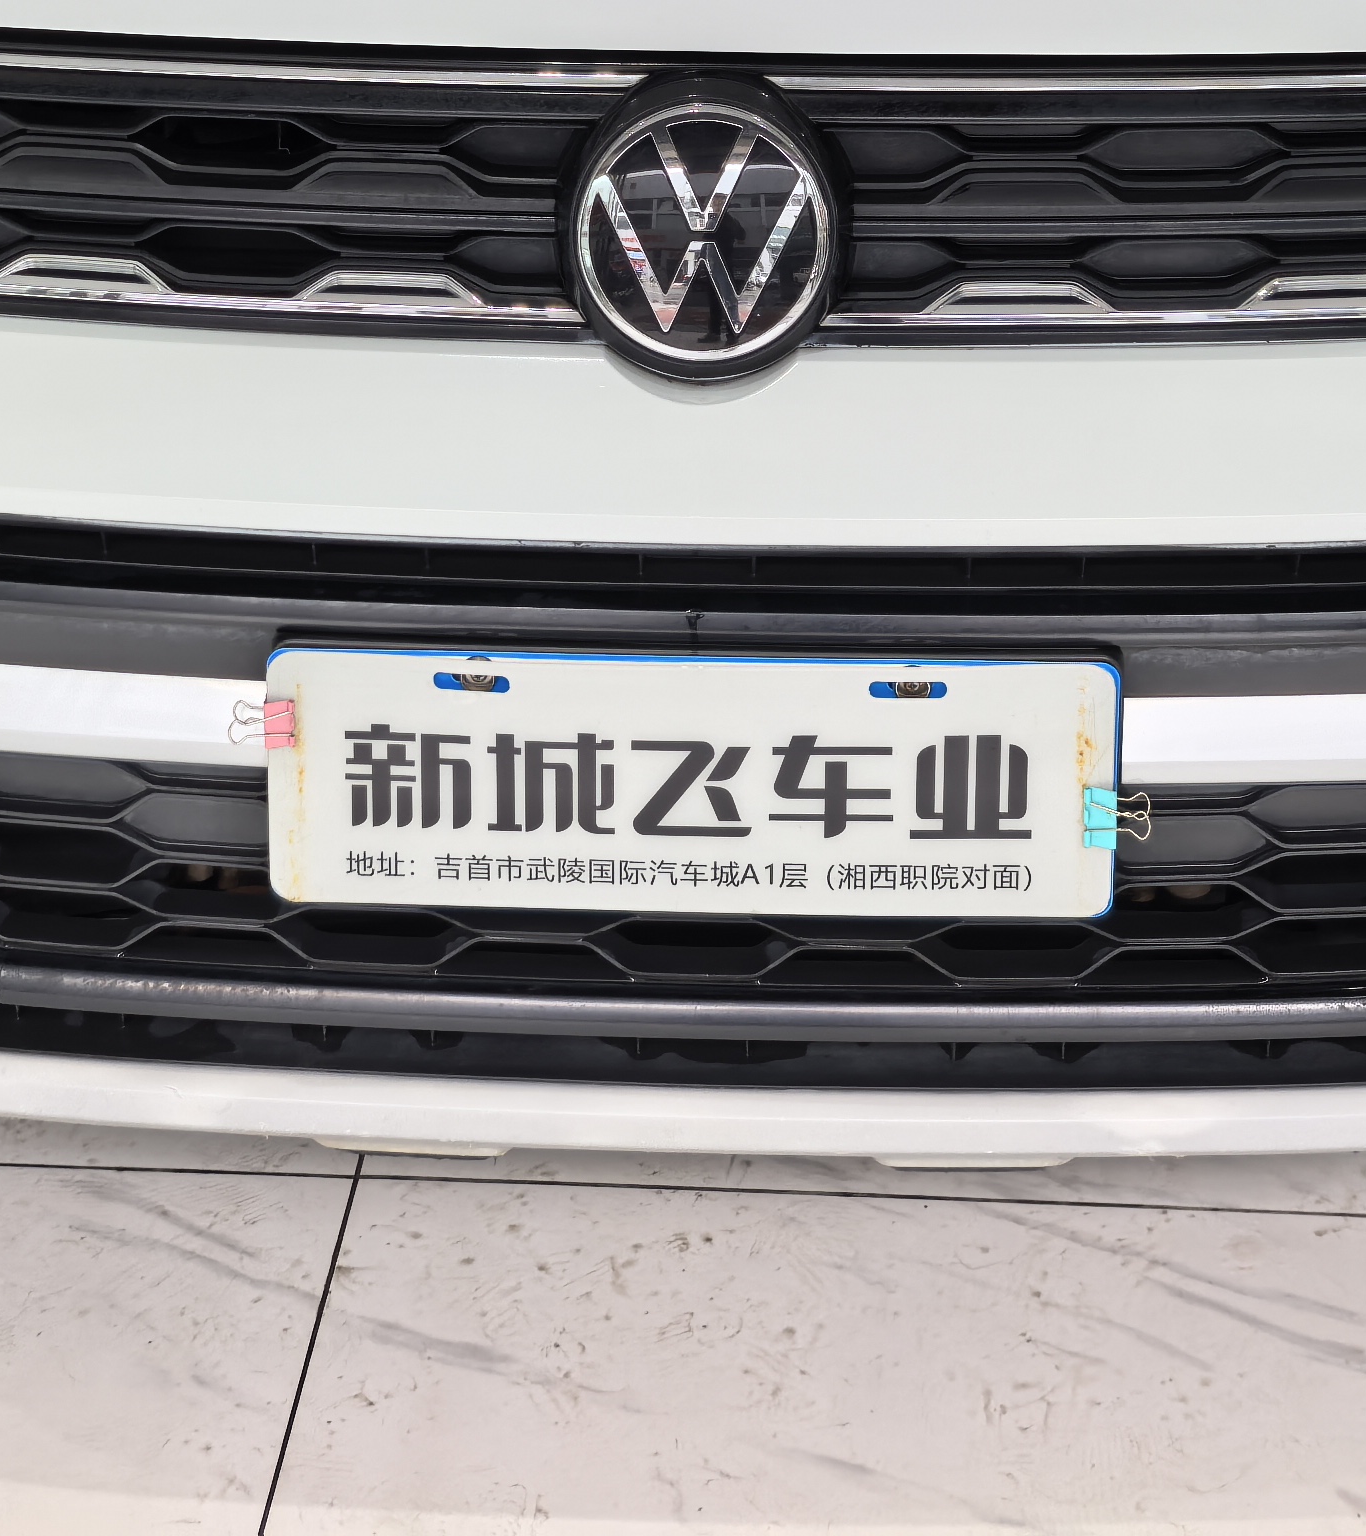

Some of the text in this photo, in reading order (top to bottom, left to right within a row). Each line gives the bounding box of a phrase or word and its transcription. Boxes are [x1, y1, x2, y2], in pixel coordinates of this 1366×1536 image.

[344, 723, 1032, 840] 新城飞车业
